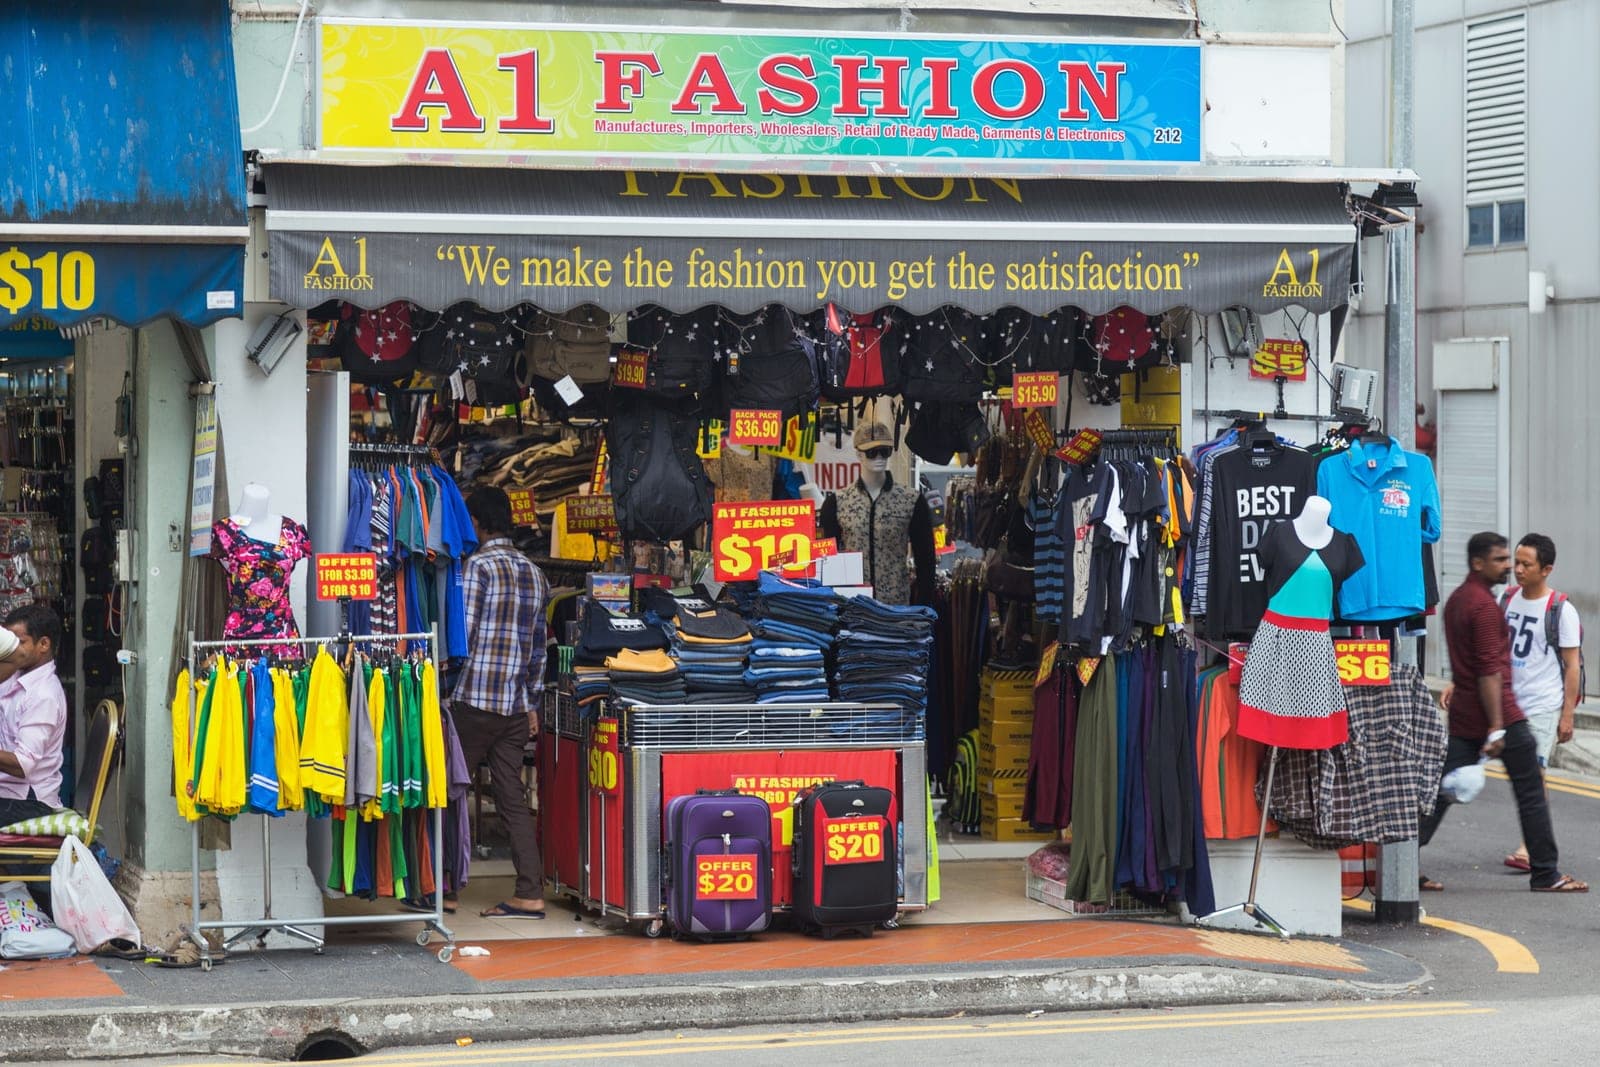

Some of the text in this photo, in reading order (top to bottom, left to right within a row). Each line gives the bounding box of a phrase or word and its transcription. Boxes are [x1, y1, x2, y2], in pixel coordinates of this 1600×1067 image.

[391, 48, 1126, 133] A1 FASHION
[594, 119, 1125, 142] Manufactures, Importers, Wholesalers, Retail of Ready Made, Garments & Electronics
[1154, 128, 1182, 143] 212
[308, 236, 372, 278] A1
[520, 247, 612, 288] make
[622, 248, 673, 288] the
[686, 248, 806, 289] fashion
[816, 259, 878, 299] you
[887, 254, 937, 299] get
[947, 251, 995, 290] the
[1267, 248, 1320, 285] A1
[0, 246, 95, 314] $10
[303, 276, 374, 290] FASHION
[1263, 284, 1323, 297] FASHION
[1260, 343, 1304, 353] FFER
[1252, 351, 1305, 375] $5
[616, 363, 644, 384] $19.90
[1039, 374, 1055, 382] PACK
[1017, 384, 1056, 404] $15.90
[735, 411, 778, 419] BACK PACK
[735, 419, 779, 438] $36.90
[1237, 485, 1295, 518] BEST
[717, 505, 811, 518] A1 FASHION
[733, 518, 795, 529] JEANS
[720, 533, 811, 576] $10
[319, 558, 373, 567] OFFER
[325, 569, 343, 581] FOR
[344, 568, 374, 581] $3.90
[322, 585, 329, 596] 3
[330, 585, 348, 596] FOR
[1336, 643, 1388, 652] OFFER
[1337, 654, 1390, 681] $6
[735, 777, 756, 788] A1
[739, 791, 785, 804] RGO
[828, 821, 880, 833] OFFER
[828, 834, 881, 861] $20
[699, 861, 753, 871] OFFER
[699, 872, 753, 895] $20
